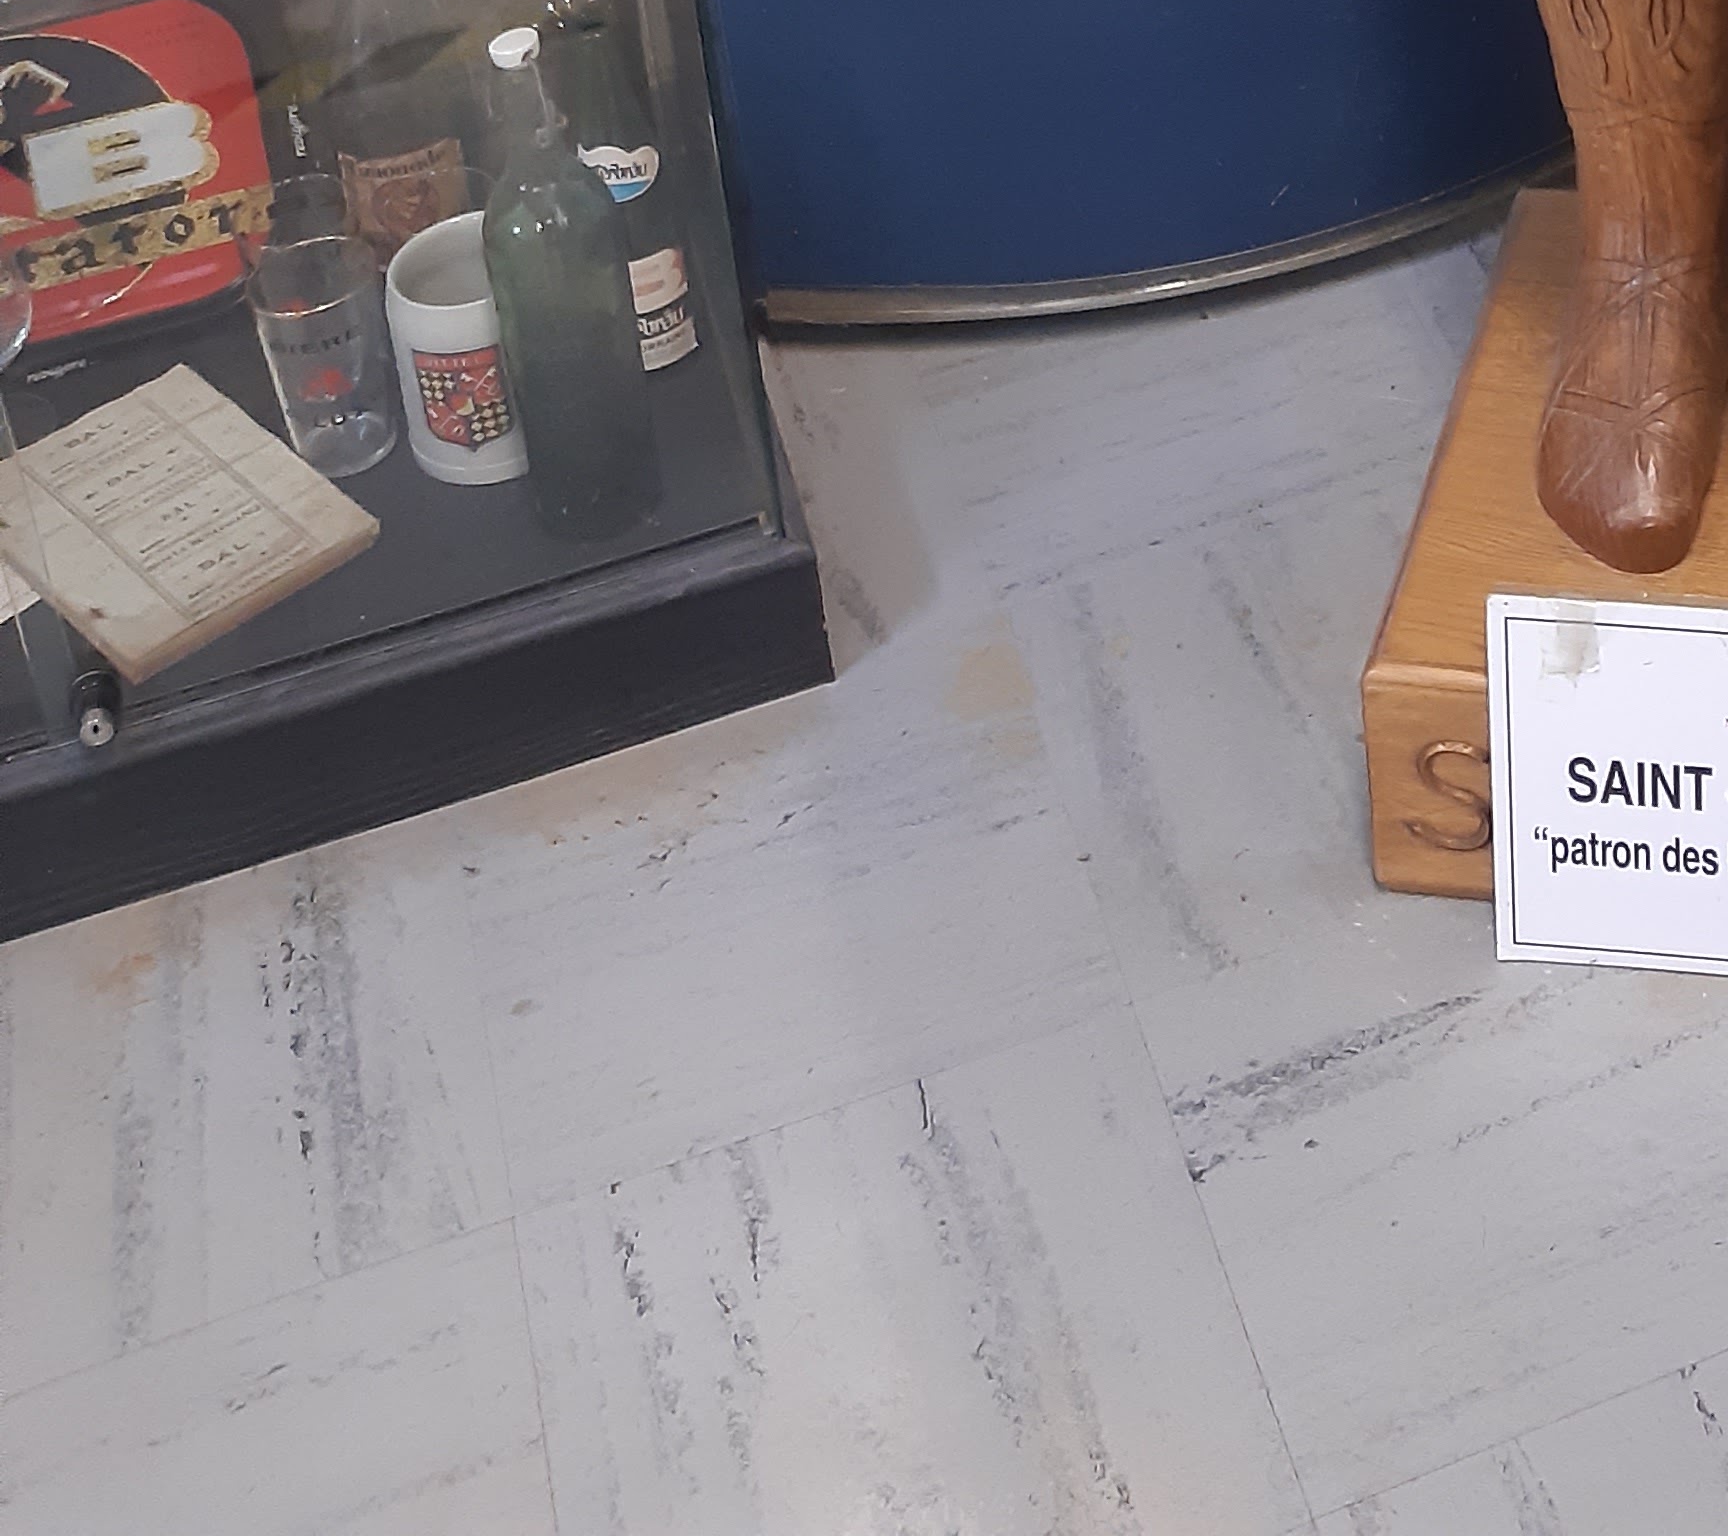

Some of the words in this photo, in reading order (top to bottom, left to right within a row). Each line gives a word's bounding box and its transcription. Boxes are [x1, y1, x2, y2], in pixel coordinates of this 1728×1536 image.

[22, 100, 221, 221] B
[196, 541, 251, 572] BAL
[1566, 755, 1714, 815] SAINT
[1533, 825, 1653, 876] “patron
[1661, 834, 1721, 877] des
